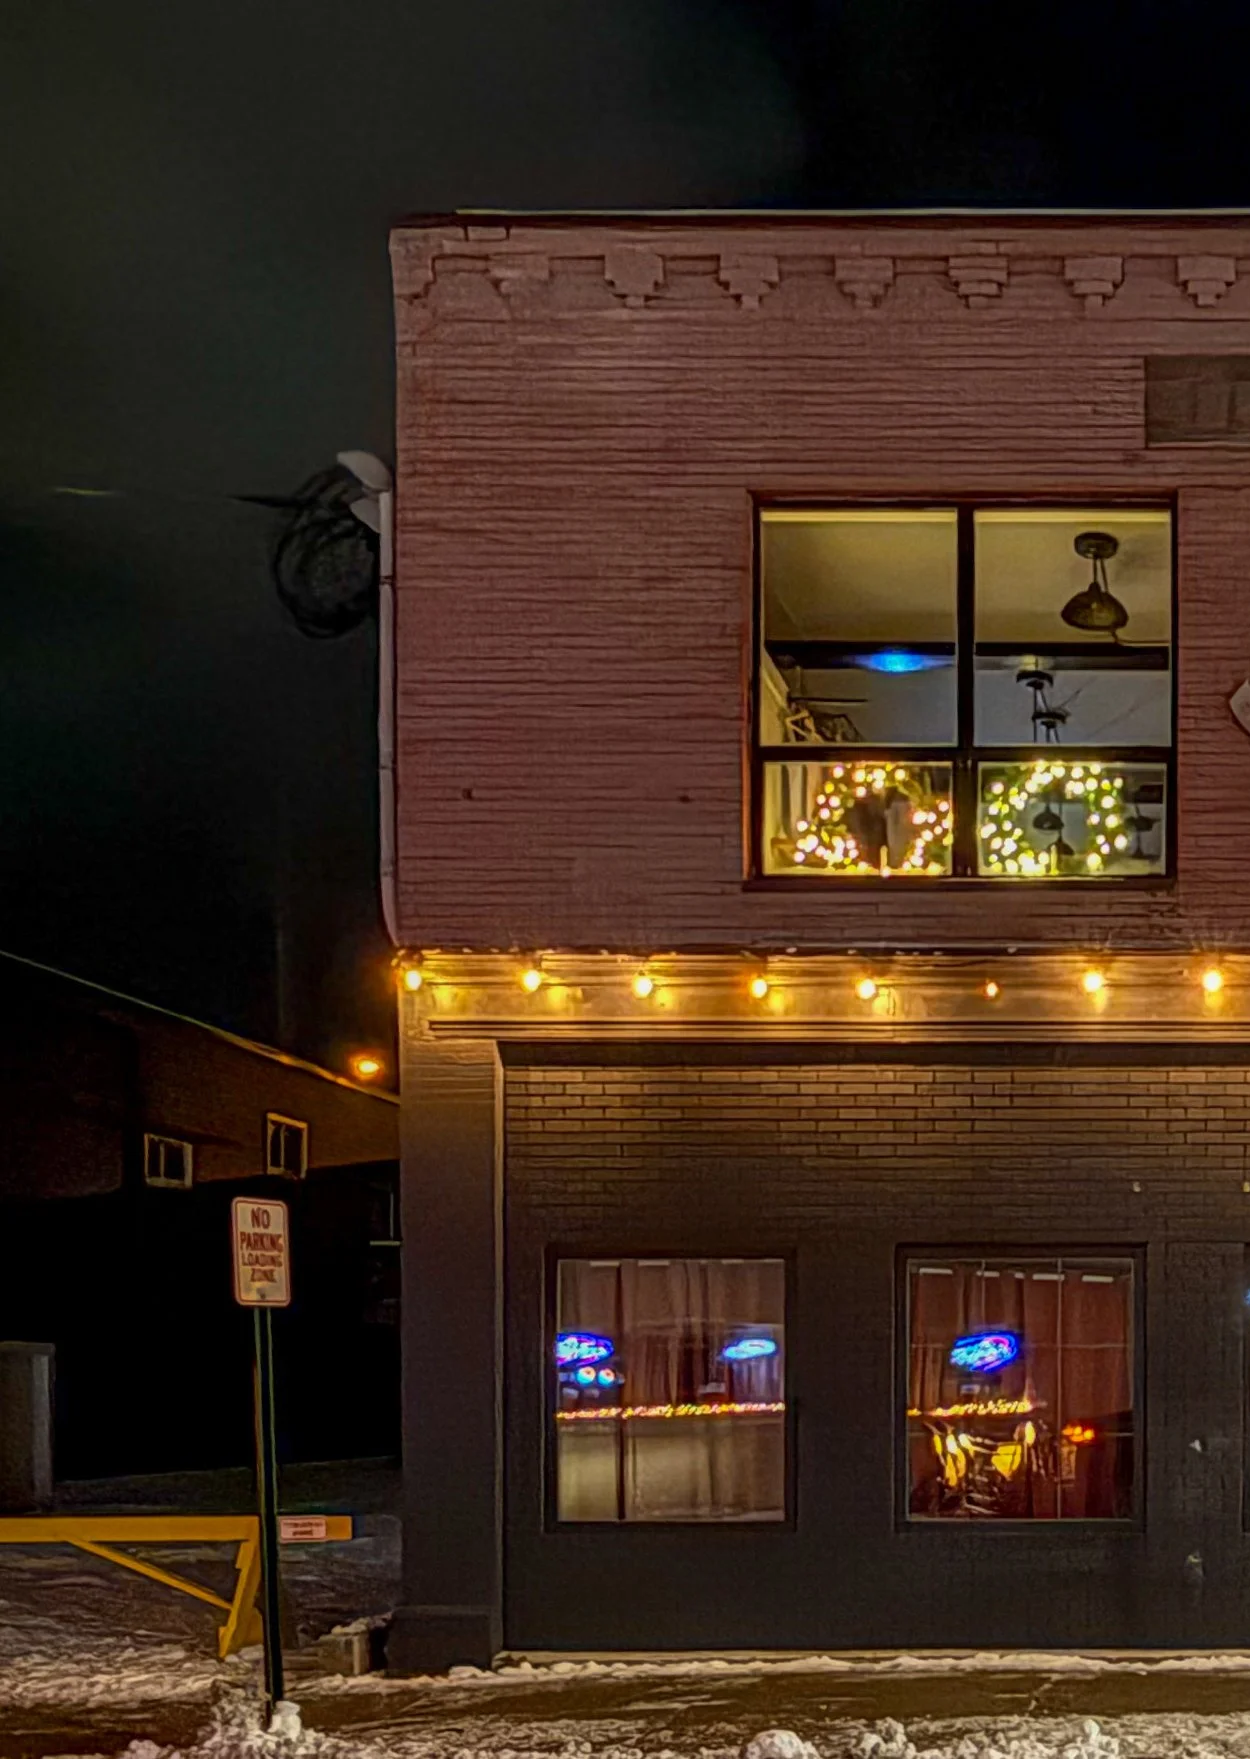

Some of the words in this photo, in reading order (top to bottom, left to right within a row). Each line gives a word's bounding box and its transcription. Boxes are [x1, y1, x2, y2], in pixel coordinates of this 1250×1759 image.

[251, 1207, 270, 1229] NO
[240, 1231, 283, 1253] PARKING
[241, 1253, 283, 1267] LOADING
[250, 1268, 277, 1283] ZONE
